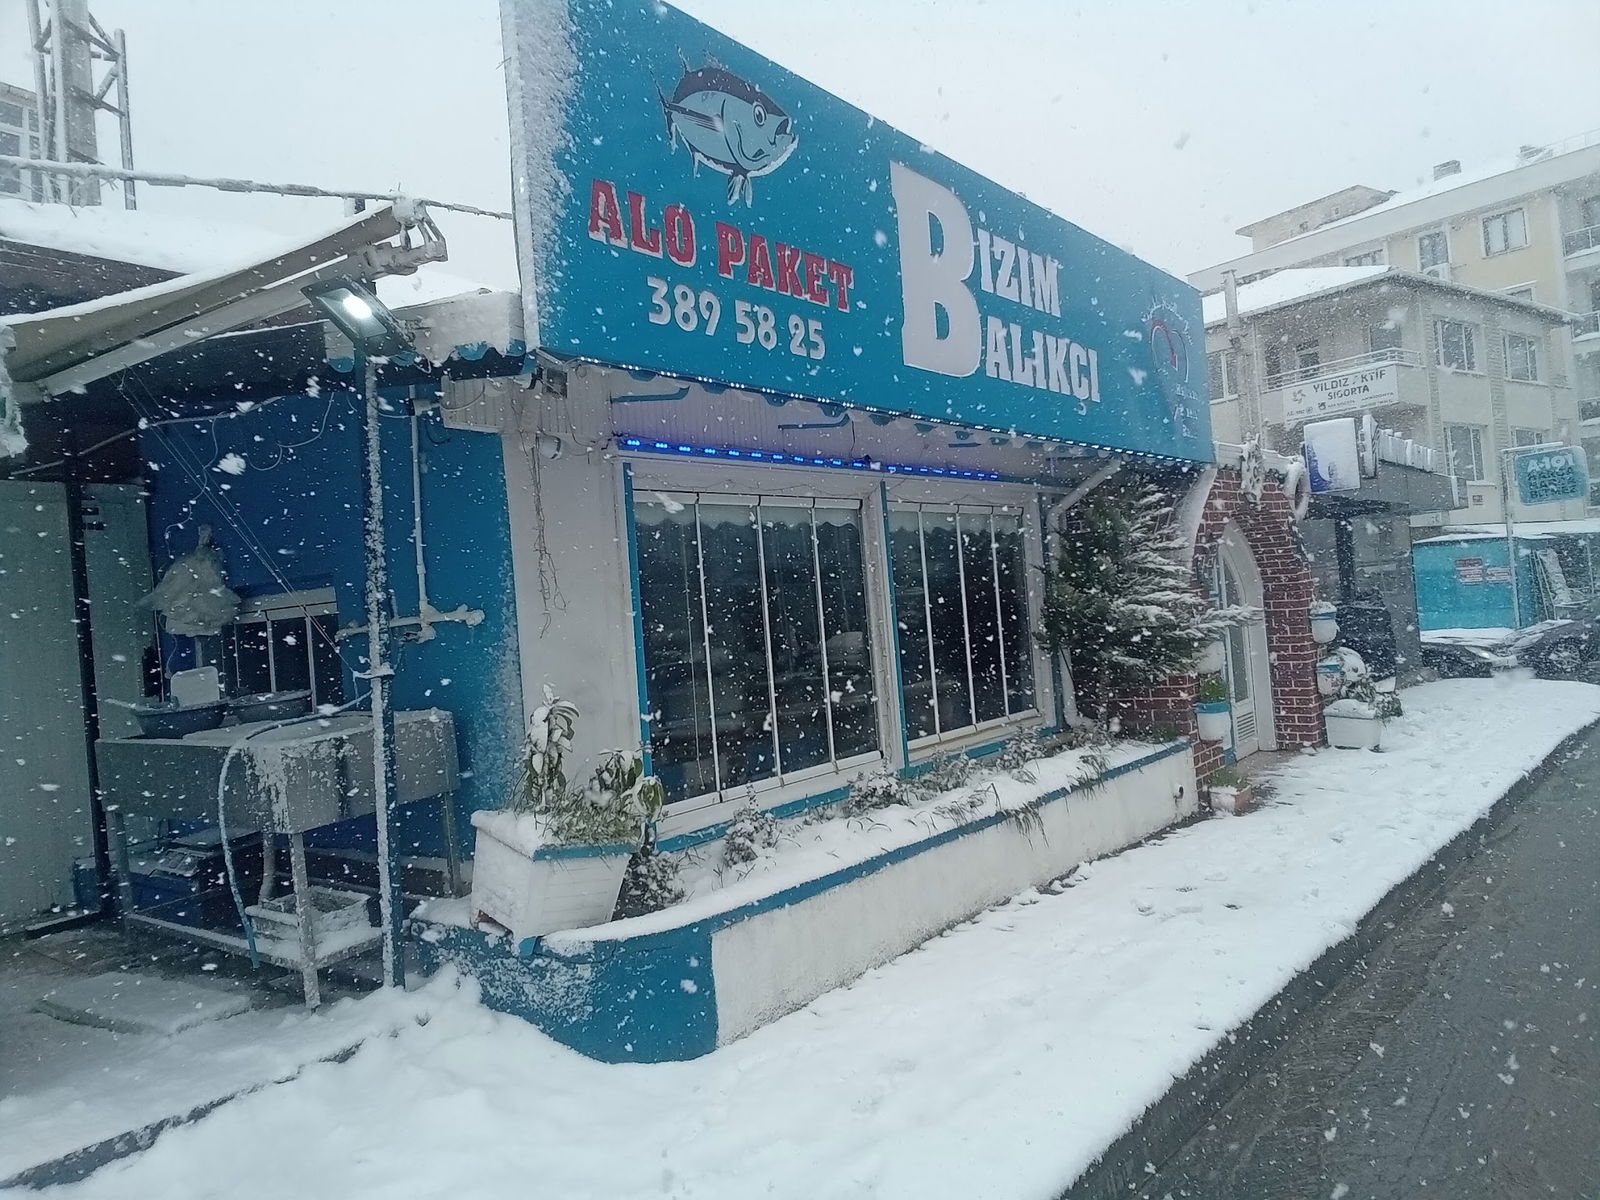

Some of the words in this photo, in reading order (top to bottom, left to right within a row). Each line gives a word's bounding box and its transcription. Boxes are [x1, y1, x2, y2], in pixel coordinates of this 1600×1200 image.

[588, 178, 697, 267] ALO
[716, 221, 856, 313] PAKET
[647, 275, 722, 336] 389
[734, 299, 778, 351] 58
[788, 314, 826, 360] 25
